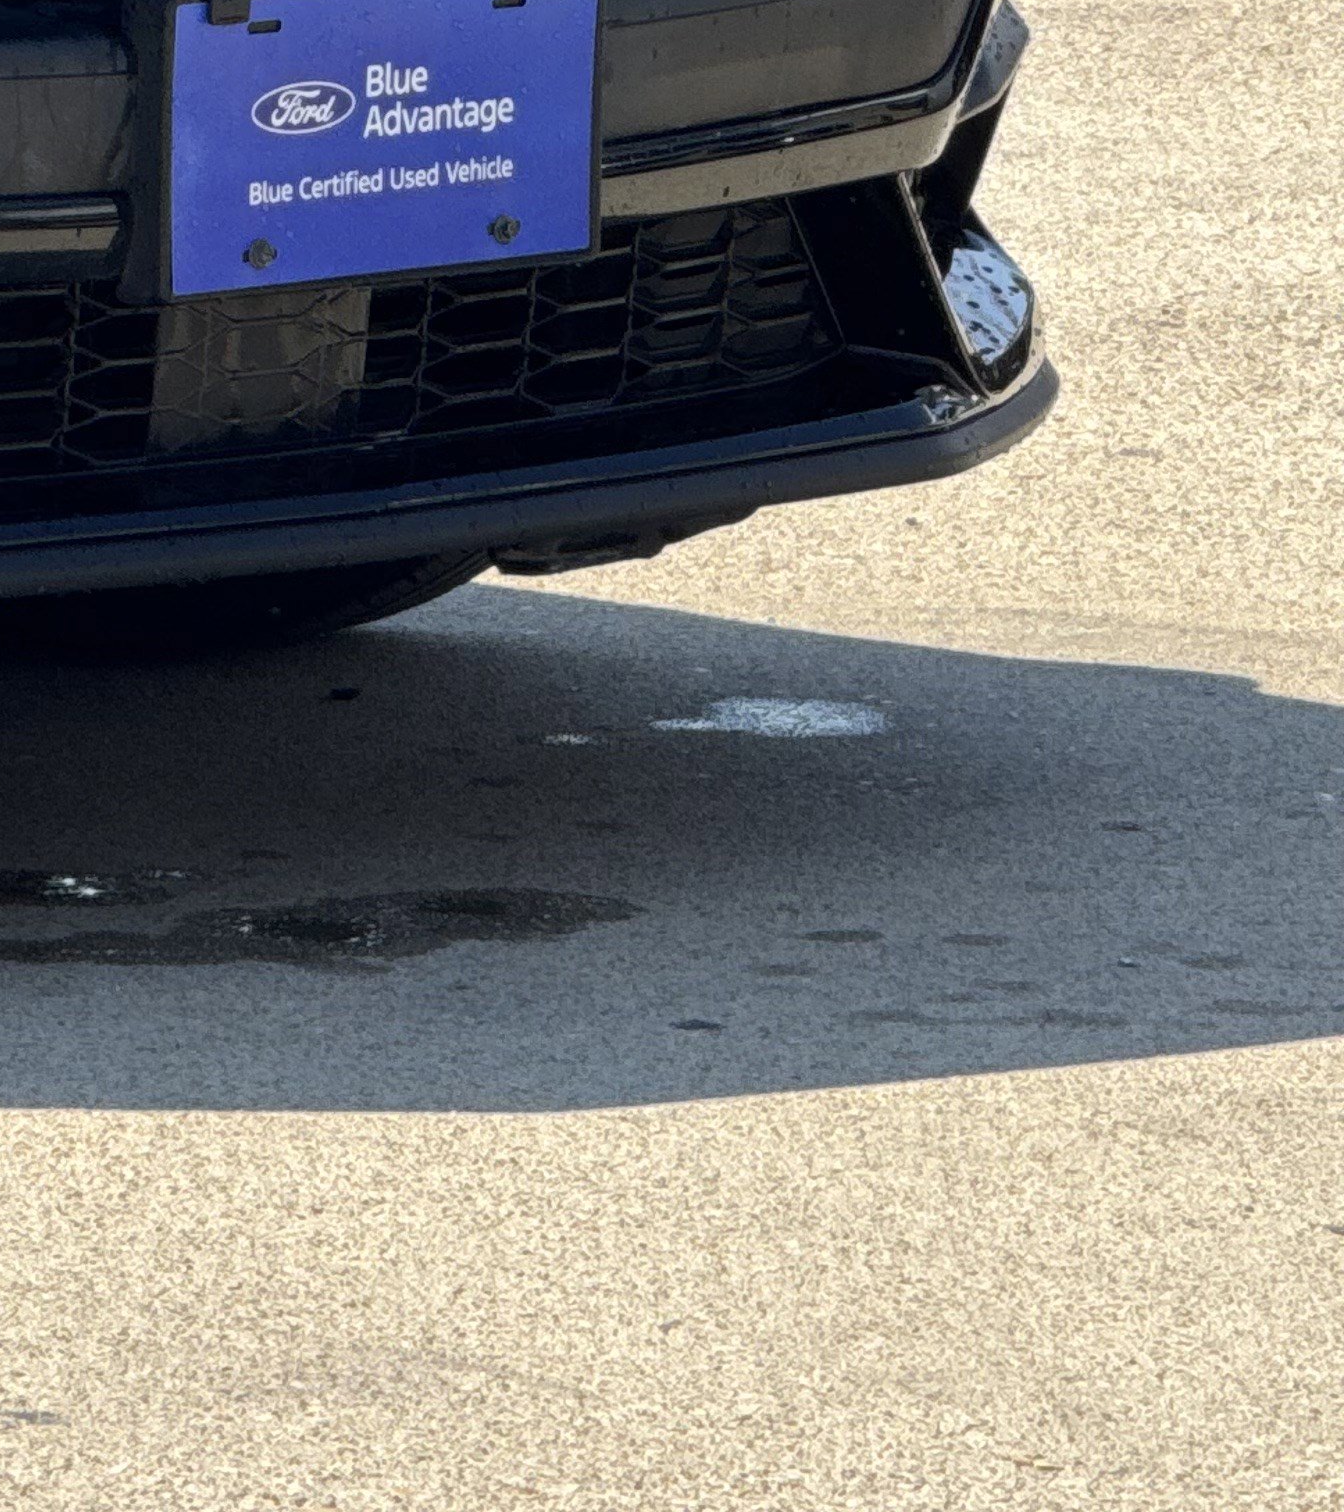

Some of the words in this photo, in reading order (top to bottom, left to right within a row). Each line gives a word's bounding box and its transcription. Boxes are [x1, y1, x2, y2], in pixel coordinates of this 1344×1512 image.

[365, 61, 429, 98] Blue
[271, 89, 334, 128] Ford
[363, 96, 515, 139] Advantage
[248, 181, 294, 207] Blue
[298, 168, 383, 200] Certified
[390, 163, 439, 191] Used
[445, 155, 514, 183] Vehicle
